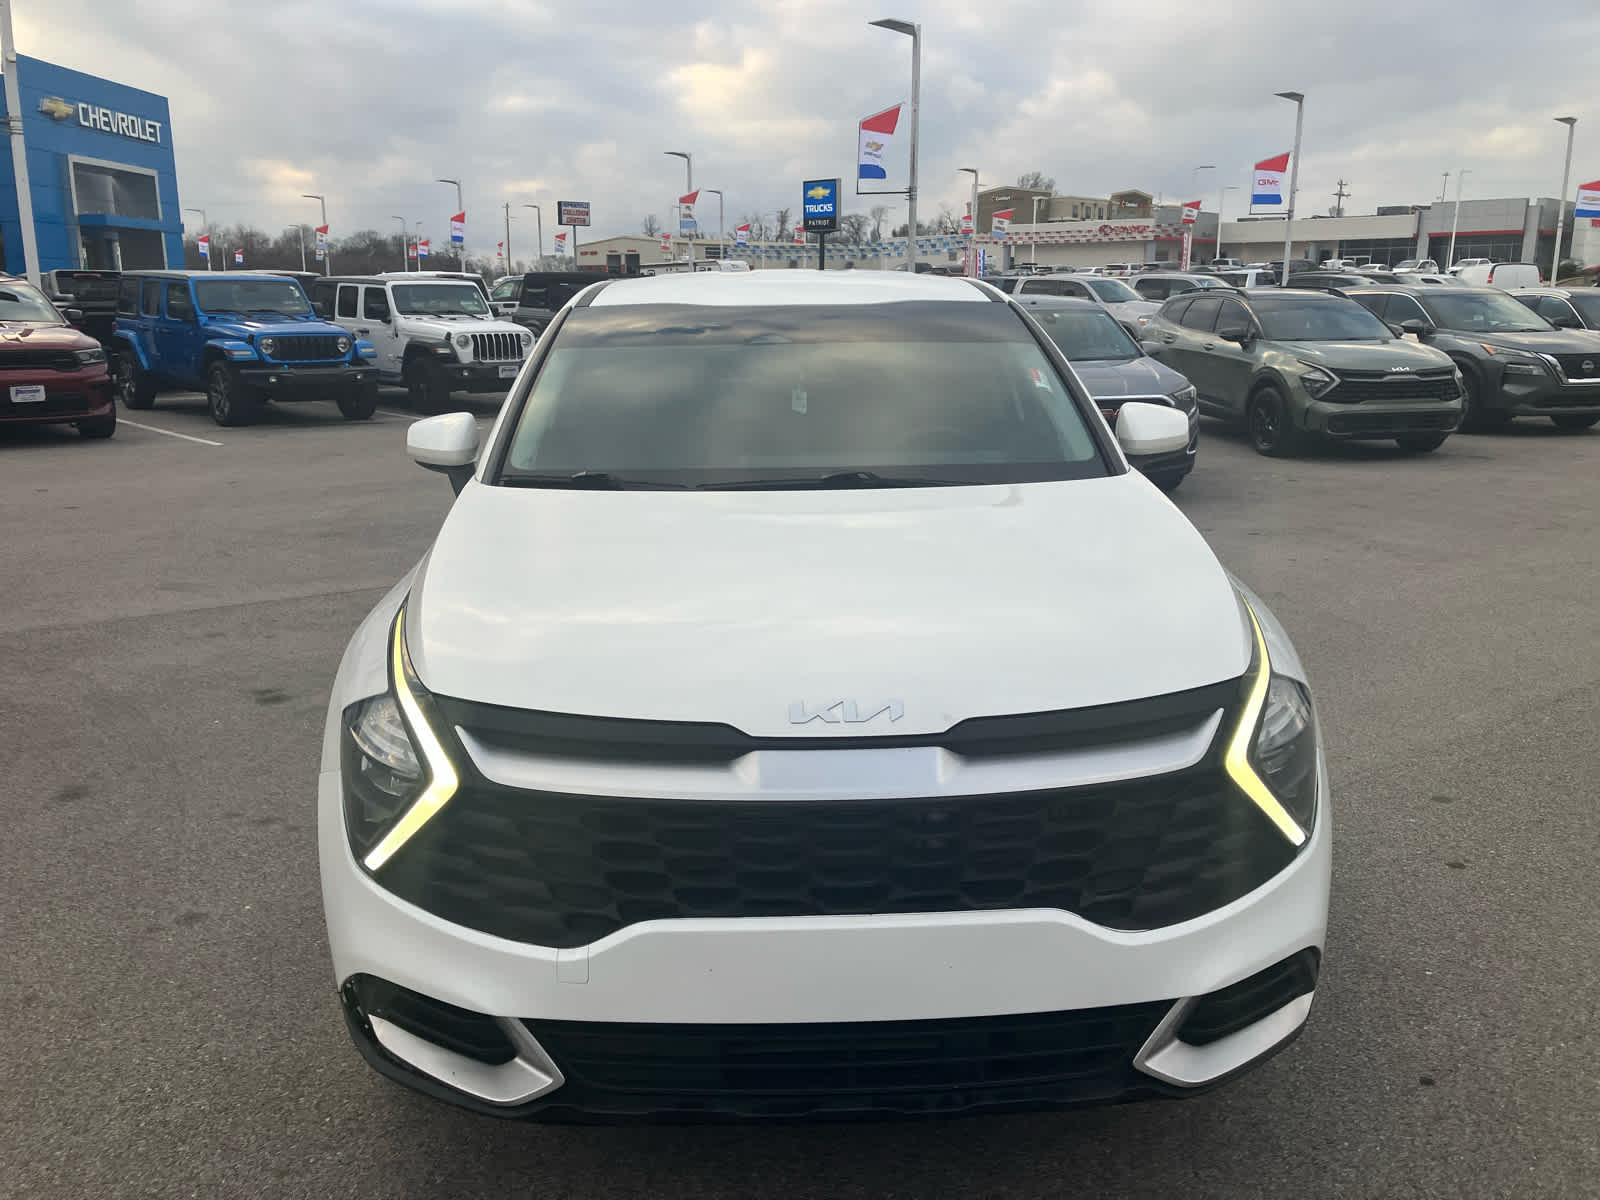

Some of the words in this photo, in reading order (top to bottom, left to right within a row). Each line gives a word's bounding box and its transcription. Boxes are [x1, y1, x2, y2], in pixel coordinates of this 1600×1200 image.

[78, 103, 161, 143] CHEVROLET
[805, 203, 832, 212] TRUCKS
[788, 699, 905, 724] KIA
